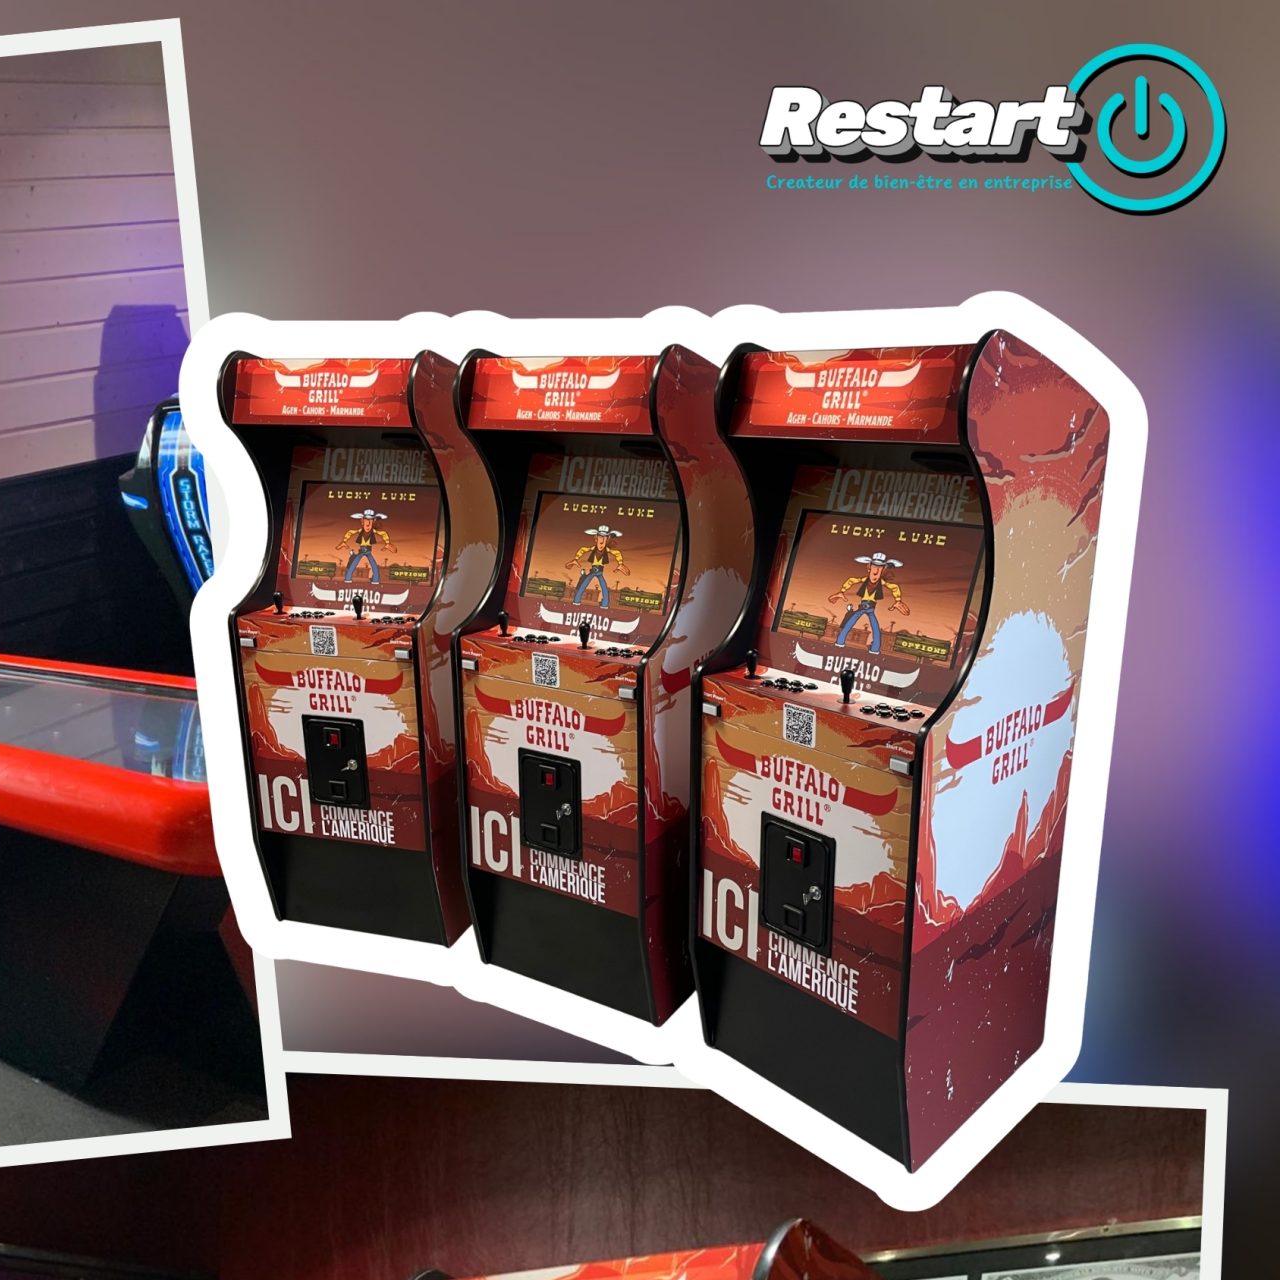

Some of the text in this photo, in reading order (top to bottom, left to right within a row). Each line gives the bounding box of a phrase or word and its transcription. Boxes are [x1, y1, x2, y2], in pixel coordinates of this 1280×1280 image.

[302, 372, 349, 388] BUFFALO
[539, 371, 588, 390] BUFFALO
[817, 367, 879, 389] BUFFALO
[323, 447, 355, 482] ICI
[355, 449, 428, 467] COMMENCE
[559, 455, 593, 493] ICI
[870, 471, 974, 499] COMMENCE
[179, 478, 201, 529] STORM
[328, 490, 372, 500] LUCKY
[826, 468, 870, 512] ICI
[563, 502, 608, 515] LUCKY
[830, 524, 948, 547] LUCKY LUKE
[337, 588, 381, 605] BUFFALO
[901, 640, 948, 655] OPTIONS
[296, 669, 362, 693] BUFFALO
[824, 654, 881, 682] BUFFALO
[515, 699, 582, 731] BUFFALO
[985, 704, 1043, 757] BUFFALO
[760, 755, 840, 802] BUFFALO
[258, 773, 314, 834] ICI
[320, 804, 395, 828] COMMENCE
[321, 820, 396, 845] L'AMERIQUE
[470, 805, 522, 878] ICI
[529, 848, 607, 885] COMMENCE
[530, 863, 607, 904] L'AMERIQUE
[703, 868, 759, 962] ICI
[768, 930, 860, 993] COMMENCE
[767, 949, 859, 1015] L'AMERIQUE
